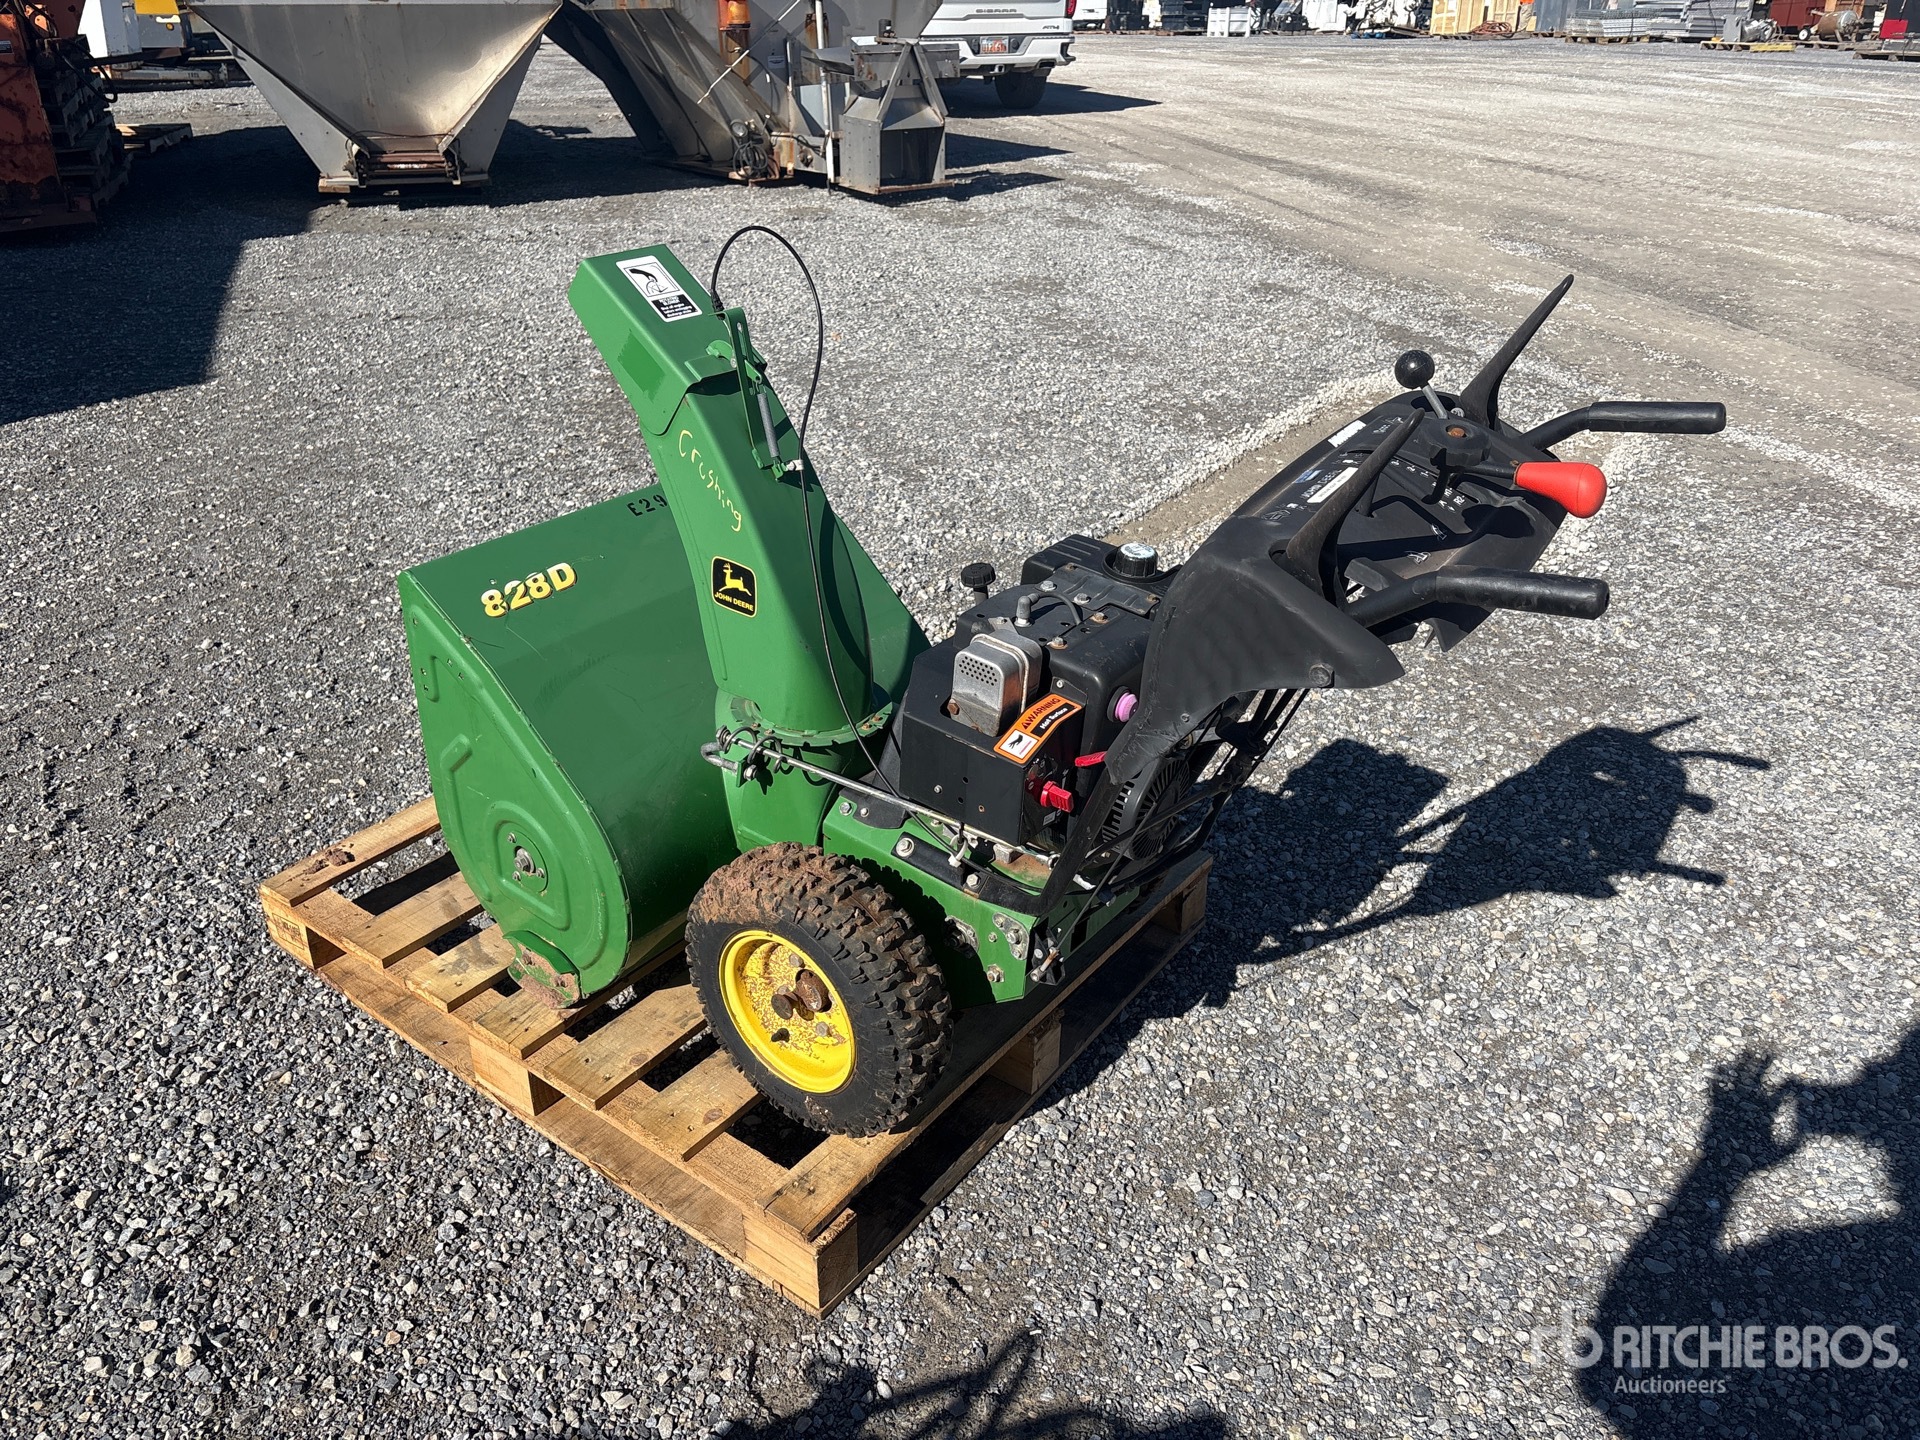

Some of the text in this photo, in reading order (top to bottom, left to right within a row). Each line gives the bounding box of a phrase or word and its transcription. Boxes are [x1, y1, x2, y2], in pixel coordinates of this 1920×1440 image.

[480, 562, 578, 618] 828D
[715, 592, 754, 611] JOHN DEERE
[1027, 698, 1061, 724] WARNING
[1040, 718, 1052, 729] Hot
